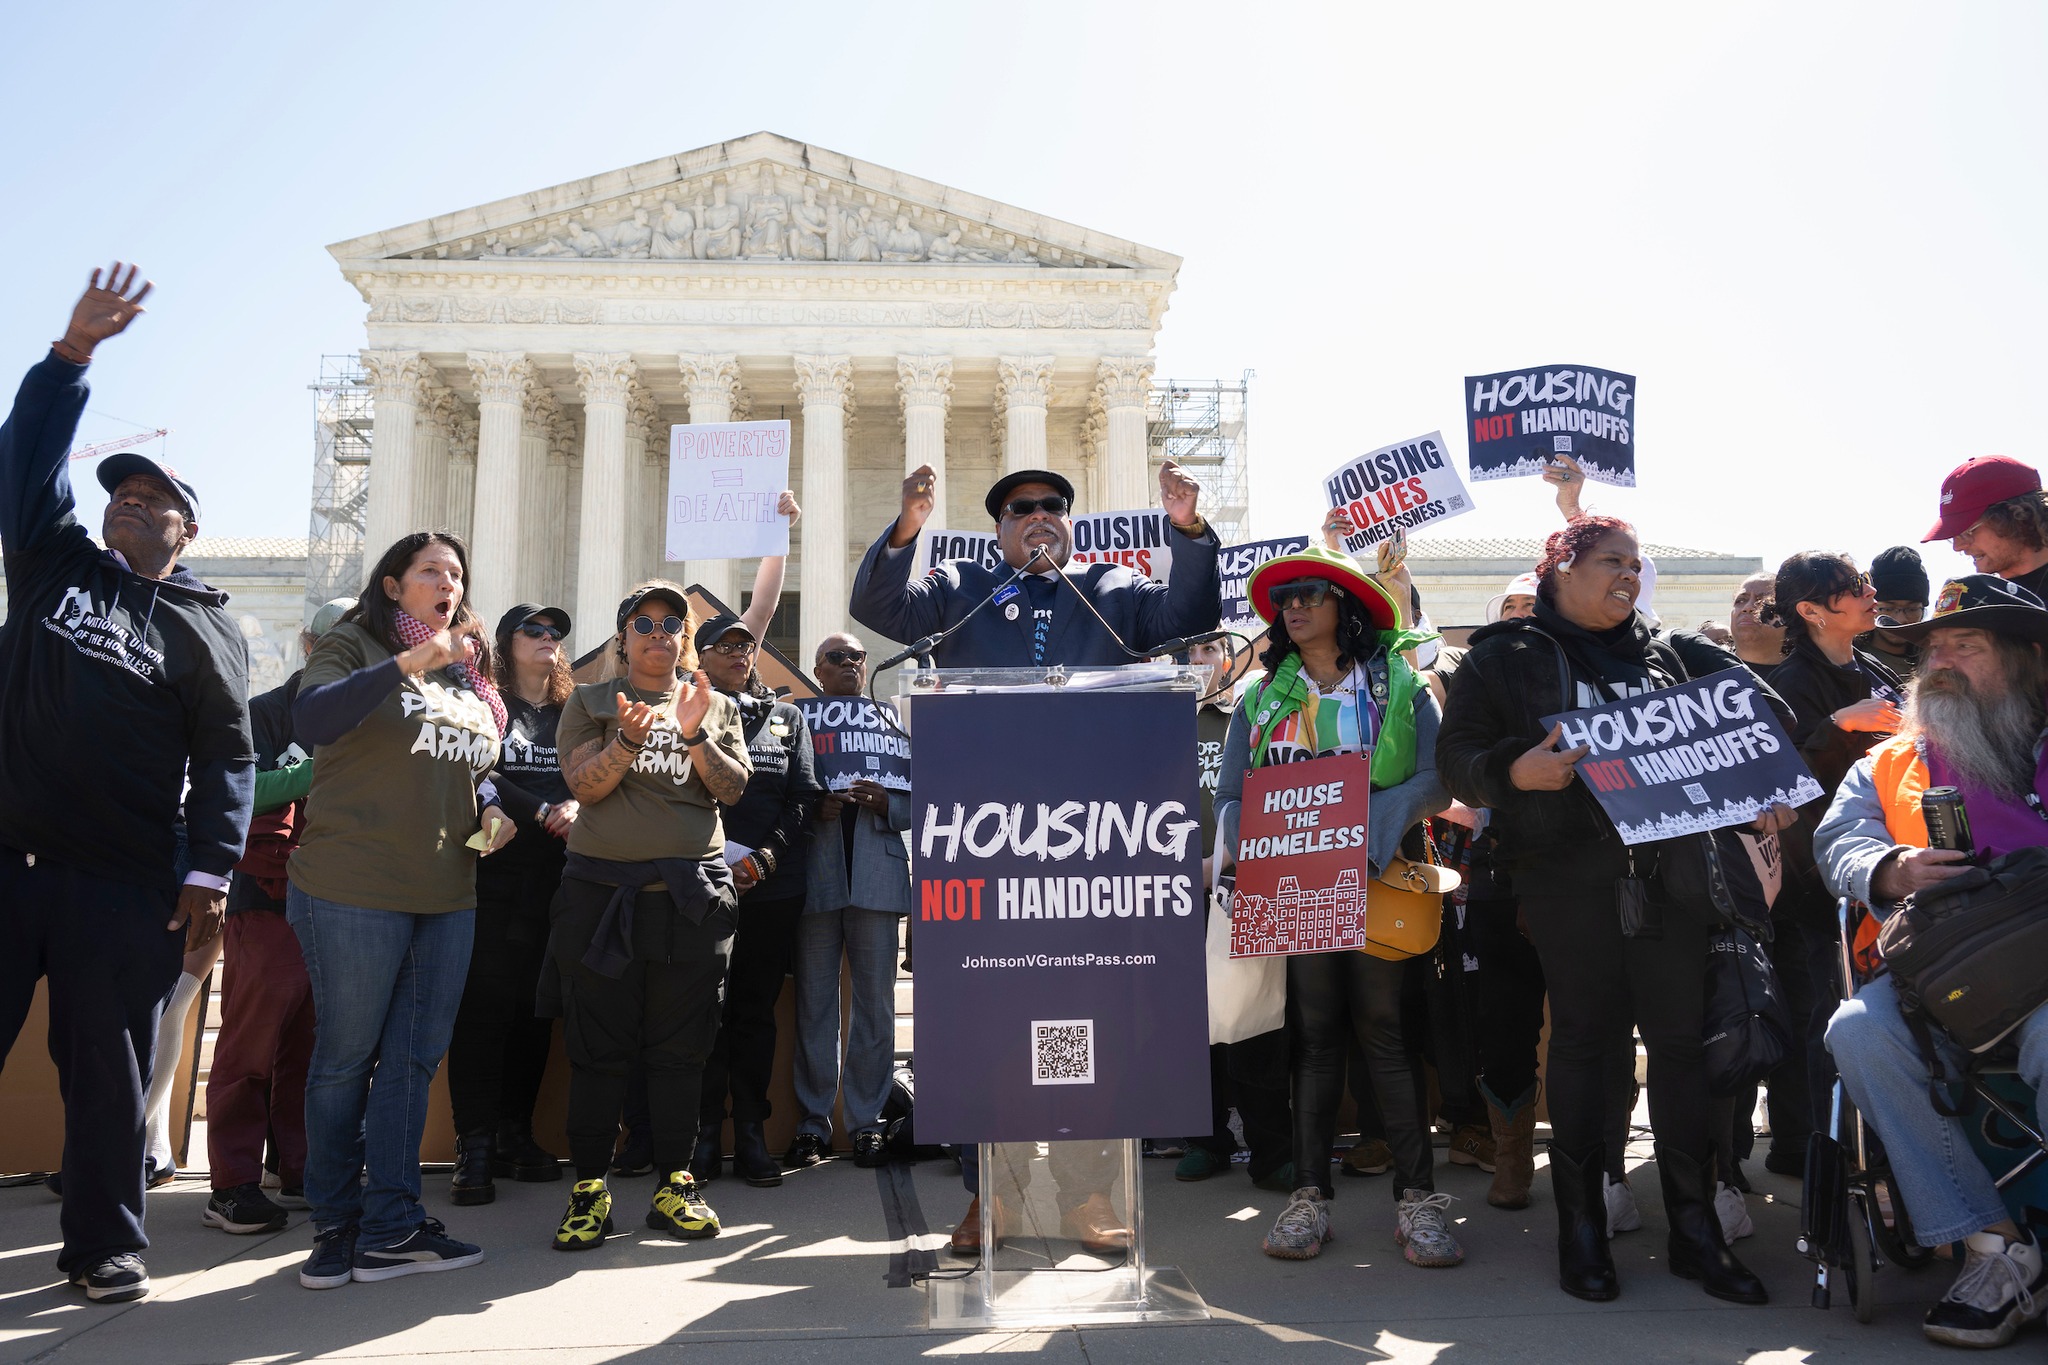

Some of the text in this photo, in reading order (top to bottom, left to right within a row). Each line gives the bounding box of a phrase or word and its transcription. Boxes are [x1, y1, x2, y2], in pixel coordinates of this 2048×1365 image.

[618, 305, 912, 323] EQUAL JUSTICE UNDER LAW
[1473, 370, 1633, 415] HOUSING
[1474, 406, 1629, 444] NOT HANDCUFFS
[678, 430, 785, 459] POVERTY
[1328, 439, 1444, 508] HOUSING
[674, 492, 777, 523] DEATH
[1345, 500, 1446, 553] HOMELESSNESS
[931, 535, 1000, 569] HOUS
[1074, 514, 1171, 552] OUSIN
[1330, 584, 1344, 598] FENDI
[74, 629, 154, 676] OF THE HOMELESS
[83, 614, 165, 664] NATIONAL UNION
[803, 701, 902, 732] HOUSIN
[1560, 679, 1756, 756] HOUSING
[411, 722, 496, 781] ARMY
[749, 755, 784, 765] HOMELESS
[761, 745, 785, 755] UNION
[812, 732, 903, 758] OT HANDCU
[1583, 721, 1780, 793] NOT HANDCUFFS
[1263, 780, 1344, 814] HOUSE
[920, 800, 1200, 862] HOUSING
[1284, 809, 1320, 830] THE
[1238, 824, 1365, 862] HOMELESS
[921, 879, 985, 921] NOT
[998, 875, 1193, 920] HANDCUFFS
[961, 953, 1156, 969] JohnsonVGrantsPass.com
